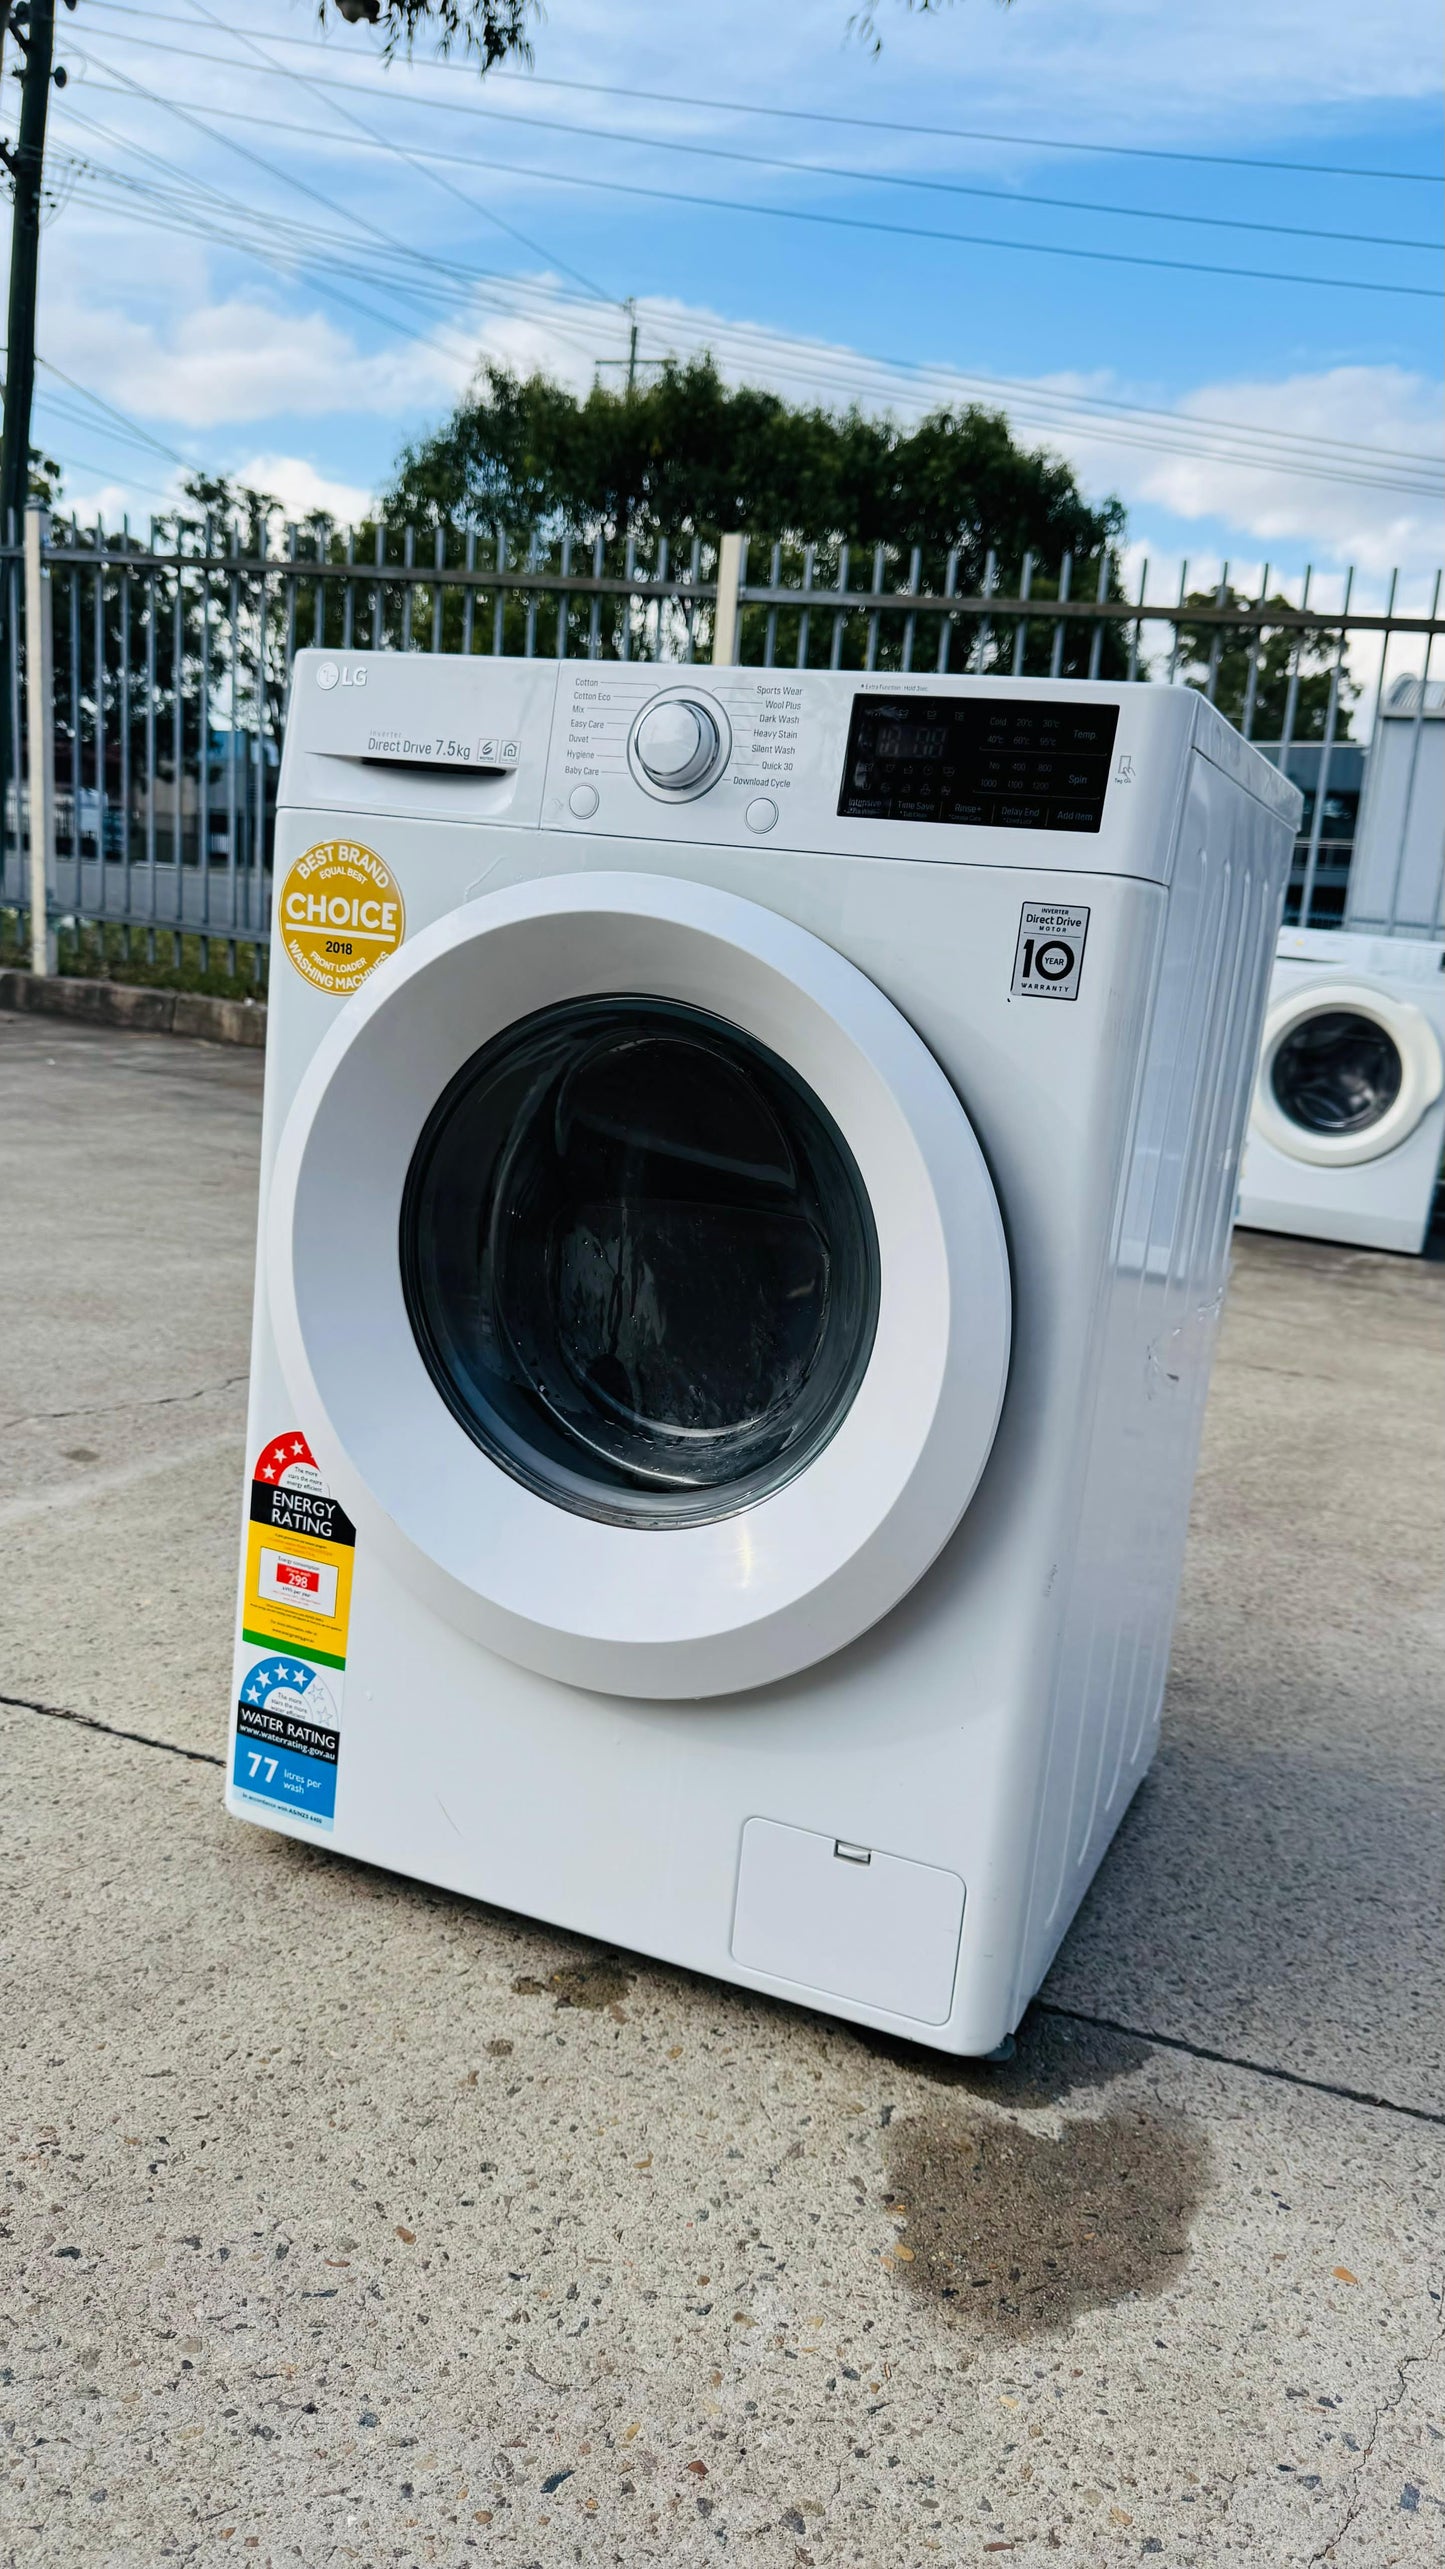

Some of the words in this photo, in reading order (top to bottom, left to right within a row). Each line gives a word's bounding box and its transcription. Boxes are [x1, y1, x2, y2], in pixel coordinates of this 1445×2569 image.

[342, 667, 368, 686] LG
[575, 678, 599, 687] Cotton
[574, 692, 597, 700] Cotton
[598, 693, 611, 701] Eco
[756, 686, 781, 696] Sports
[783, 687, 803, 696] Wear
[572, 704, 584, 713] Mix
[766, 700, 784, 709] Wool
[786, 702, 801, 710] Plus
[570, 719, 587, 728] Easy
[588, 720, 604, 728] Care
[760, 714, 776, 723] Dark
[779, 715, 800, 724] Wash
[990, 717, 1007, 726] Cold
[569, 734, 589, 743] Duvet
[754, 729, 777, 740] Heavy
[778, 730, 798, 739] Stain
[368, 738, 400, 752] Direct
[403, 740, 432, 755] Drive
[752, 744, 772, 754] Silent
[774, 746, 796, 754] Wash
[566, 750, 594, 760] Hygiene
[564, 765, 582, 775] Baby
[584, 767, 600, 776] Care
[762, 761, 782, 770] Quick
[784, 763, 794, 771] 30
[733, 776, 770, 786] Download
[770, 778, 790, 788] Cycle
[1068, 775, 1088, 785] Spin
[898, 800, 916, 809] Time
[917, 801, 936, 810] Save
[1002, 807, 1023, 817] Delay
[1024, 808, 1040, 816] End
[1057, 811, 1074, 820] Add
[296, 846, 334, 879] BEST
[338, 844, 389, 888] BRAND
[319, 866, 346, 879] EQUAL
[347, 868, 368, 885] BEST
[286, 892, 397, 930] CHOICE
[1026, 914, 1054, 925] Direct
[1056, 916, 1082, 927] Drive
[326, 940, 352, 955] 2018
[288, 939, 334, 987] WASHING
[310, 951, 336, 971] FRONT
[336, 957, 367, 972] LOADER
[1022, 939, 1075, 981] 10
[1044, 957, 1064, 966] YEAR
[1021, 982, 1070, 992] WARRANTY
[273, 1490, 336, 1519] ENERGY
[271, 1508, 332, 1536] RATING
[288, 1573, 308, 1588] 298
[241, 1708, 284, 1733] WATER
[287, 1723, 336, 1749] RATING
[239, 1724, 336, 1760] www.waterrating.gov.au
[247, 1751, 279, 1783] 77
[284, 1769, 305, 1784] litres
[307, 1778, 322, 1790] per
[283, 1781, 304, 1795] wash
